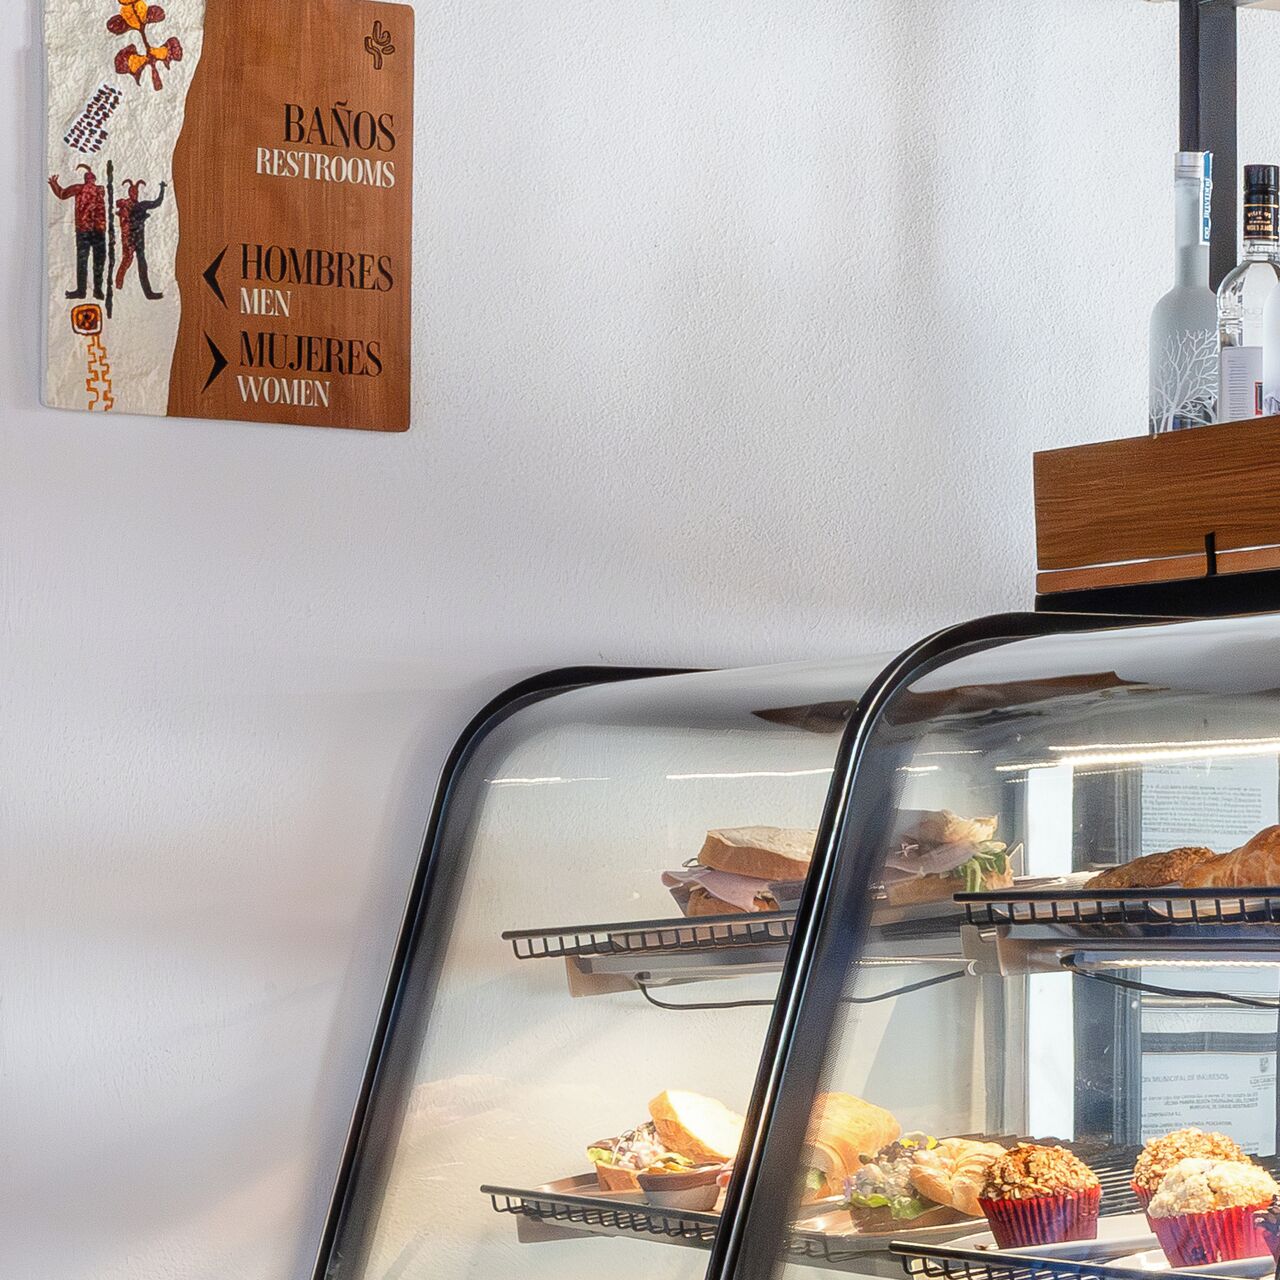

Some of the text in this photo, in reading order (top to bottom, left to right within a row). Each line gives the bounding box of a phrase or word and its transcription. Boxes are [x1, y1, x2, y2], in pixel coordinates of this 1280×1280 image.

[284, 101, 397, 152] BAÑOS
[257, 148, 396, 188] RESTROOMS
[239, 244, 394, 292] HOMBRES
[240, 287, 292, 318] MEN
[239, 331, 384, 377] MUJERES
[236, 376, 332, 408] WOMEN
